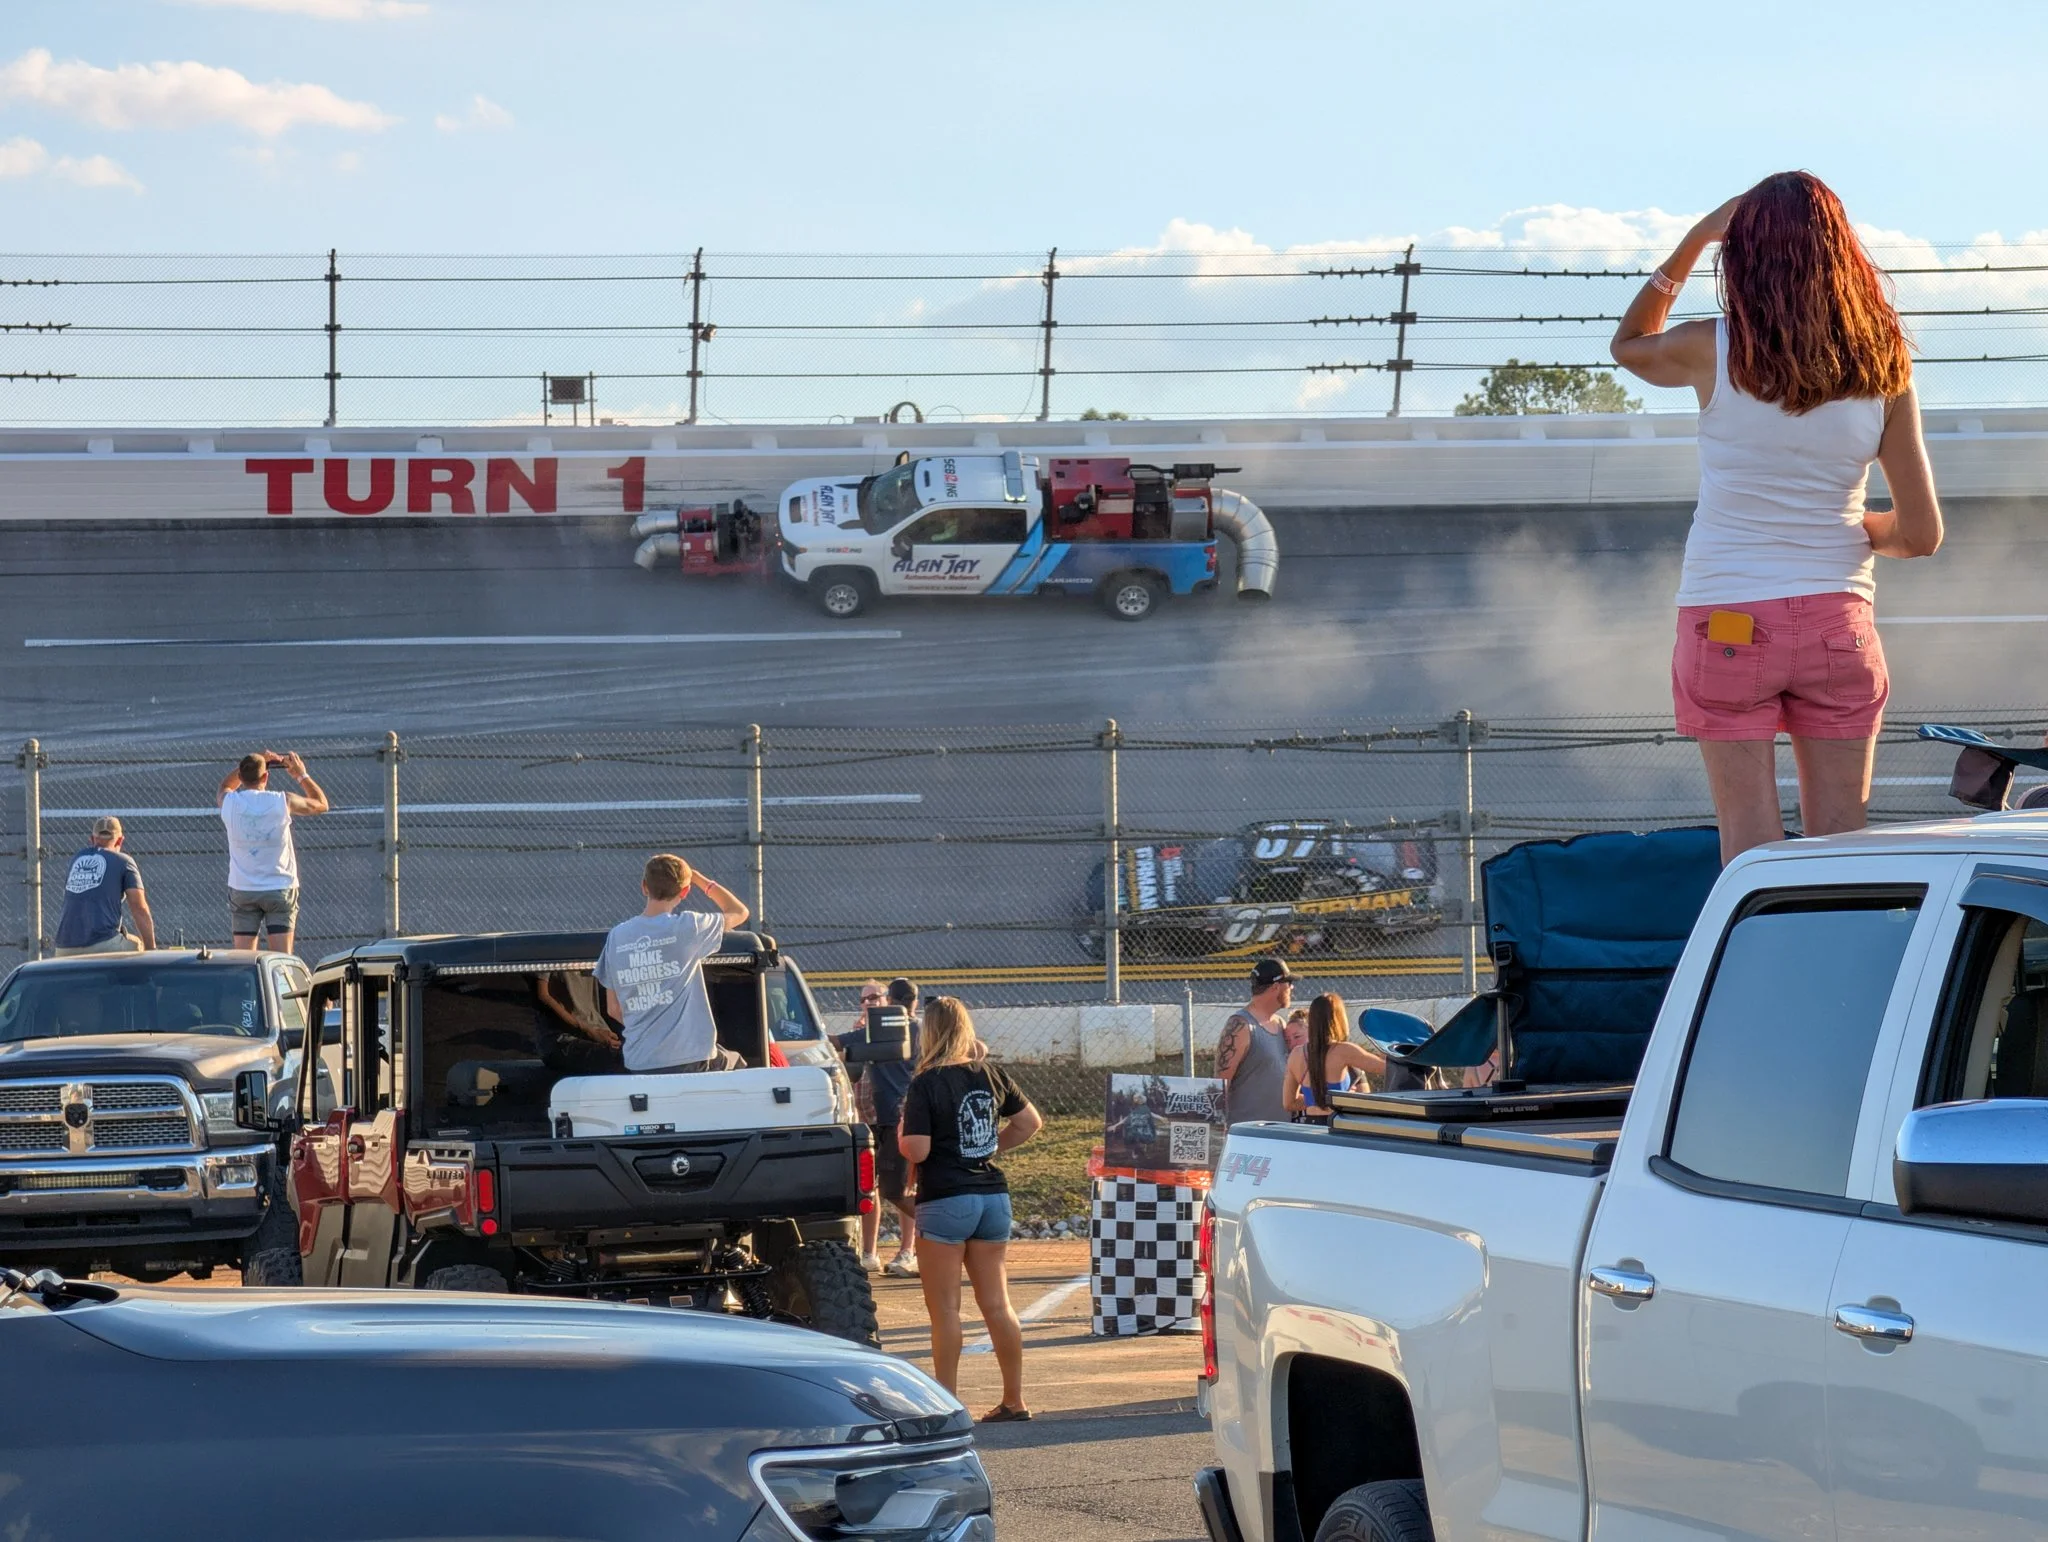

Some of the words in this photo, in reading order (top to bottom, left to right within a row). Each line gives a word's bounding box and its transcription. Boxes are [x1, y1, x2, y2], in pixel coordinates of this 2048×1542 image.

[245, 457, 558, 515] TURN
[607, 456, 646, 513] 1
[892, 559, 943, 573] ALAN
[944, 559, 981, 575] JAY
[1254, 823, 1328, 859] 07
[1224, 907, 1294, 943] 07
[628, 949, 664, 968] MAKE
[617, 960, 681, 984] PROGRESS
[636, 981, 662, 996] NOT
[1159, 1088, 1224, 1110] WHISKEY
[1167, 1101, 1213, 1116] MYERS
[426, 1170, 465, 1180] LIMITED
